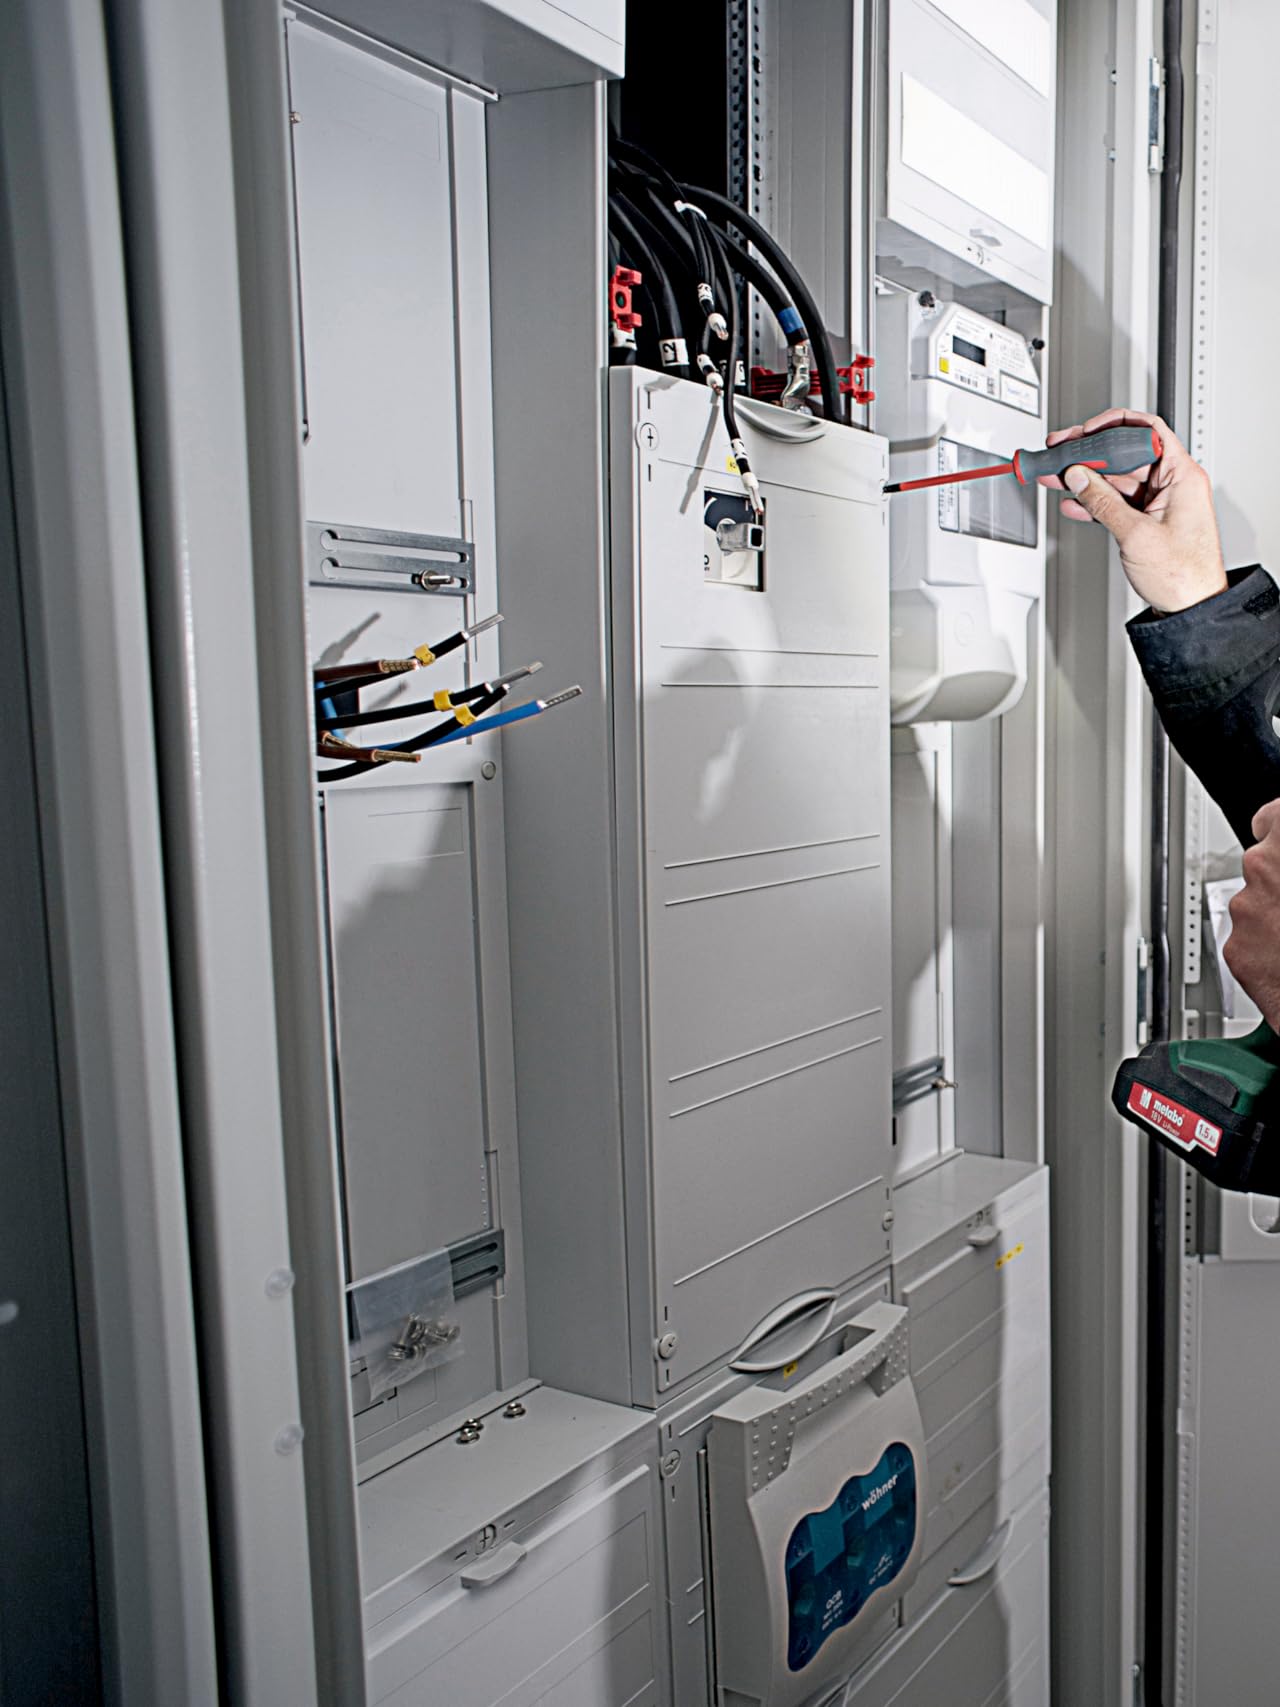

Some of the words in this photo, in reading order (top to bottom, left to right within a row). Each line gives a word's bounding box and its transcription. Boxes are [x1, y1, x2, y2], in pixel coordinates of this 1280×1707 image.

[663, 342, 677, 364] L2
[1153, 1100, 1183, 1127] metabo
[861, 1474, 898, 1510] wöhner
